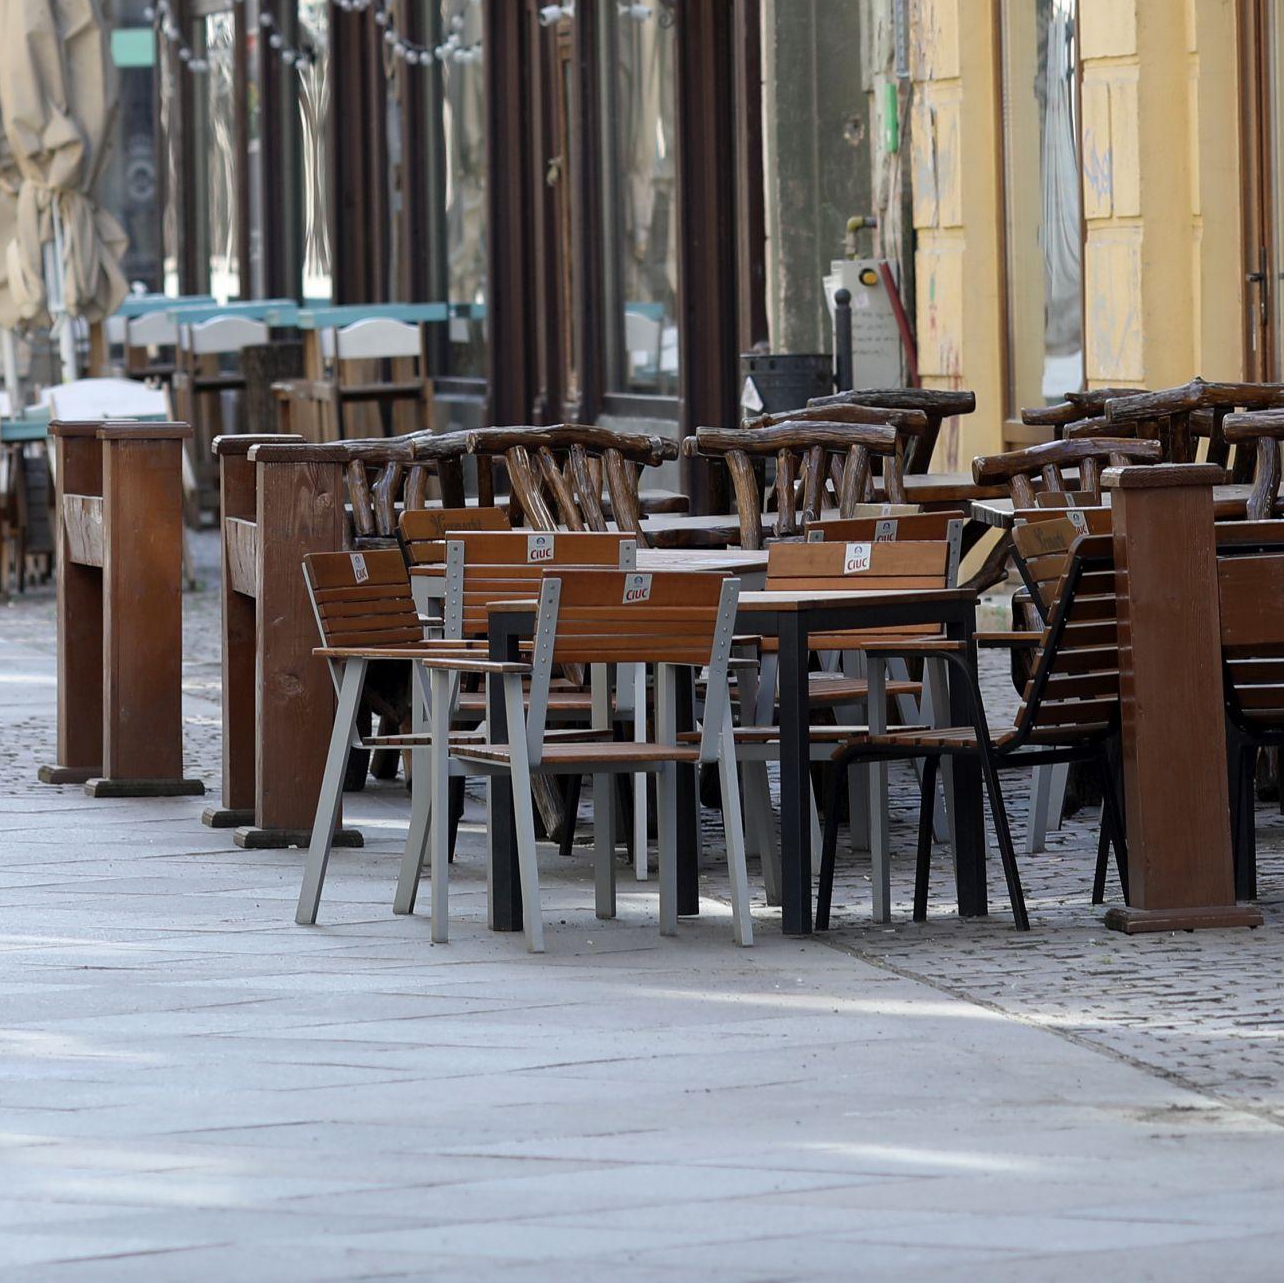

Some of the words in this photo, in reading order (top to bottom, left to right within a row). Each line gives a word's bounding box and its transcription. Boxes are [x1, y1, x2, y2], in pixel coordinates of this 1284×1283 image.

[531, 548, 552, 560] CIUC
[847, 557, 868, 571] CIUC
[626, 587, 648, 601] CIUC
